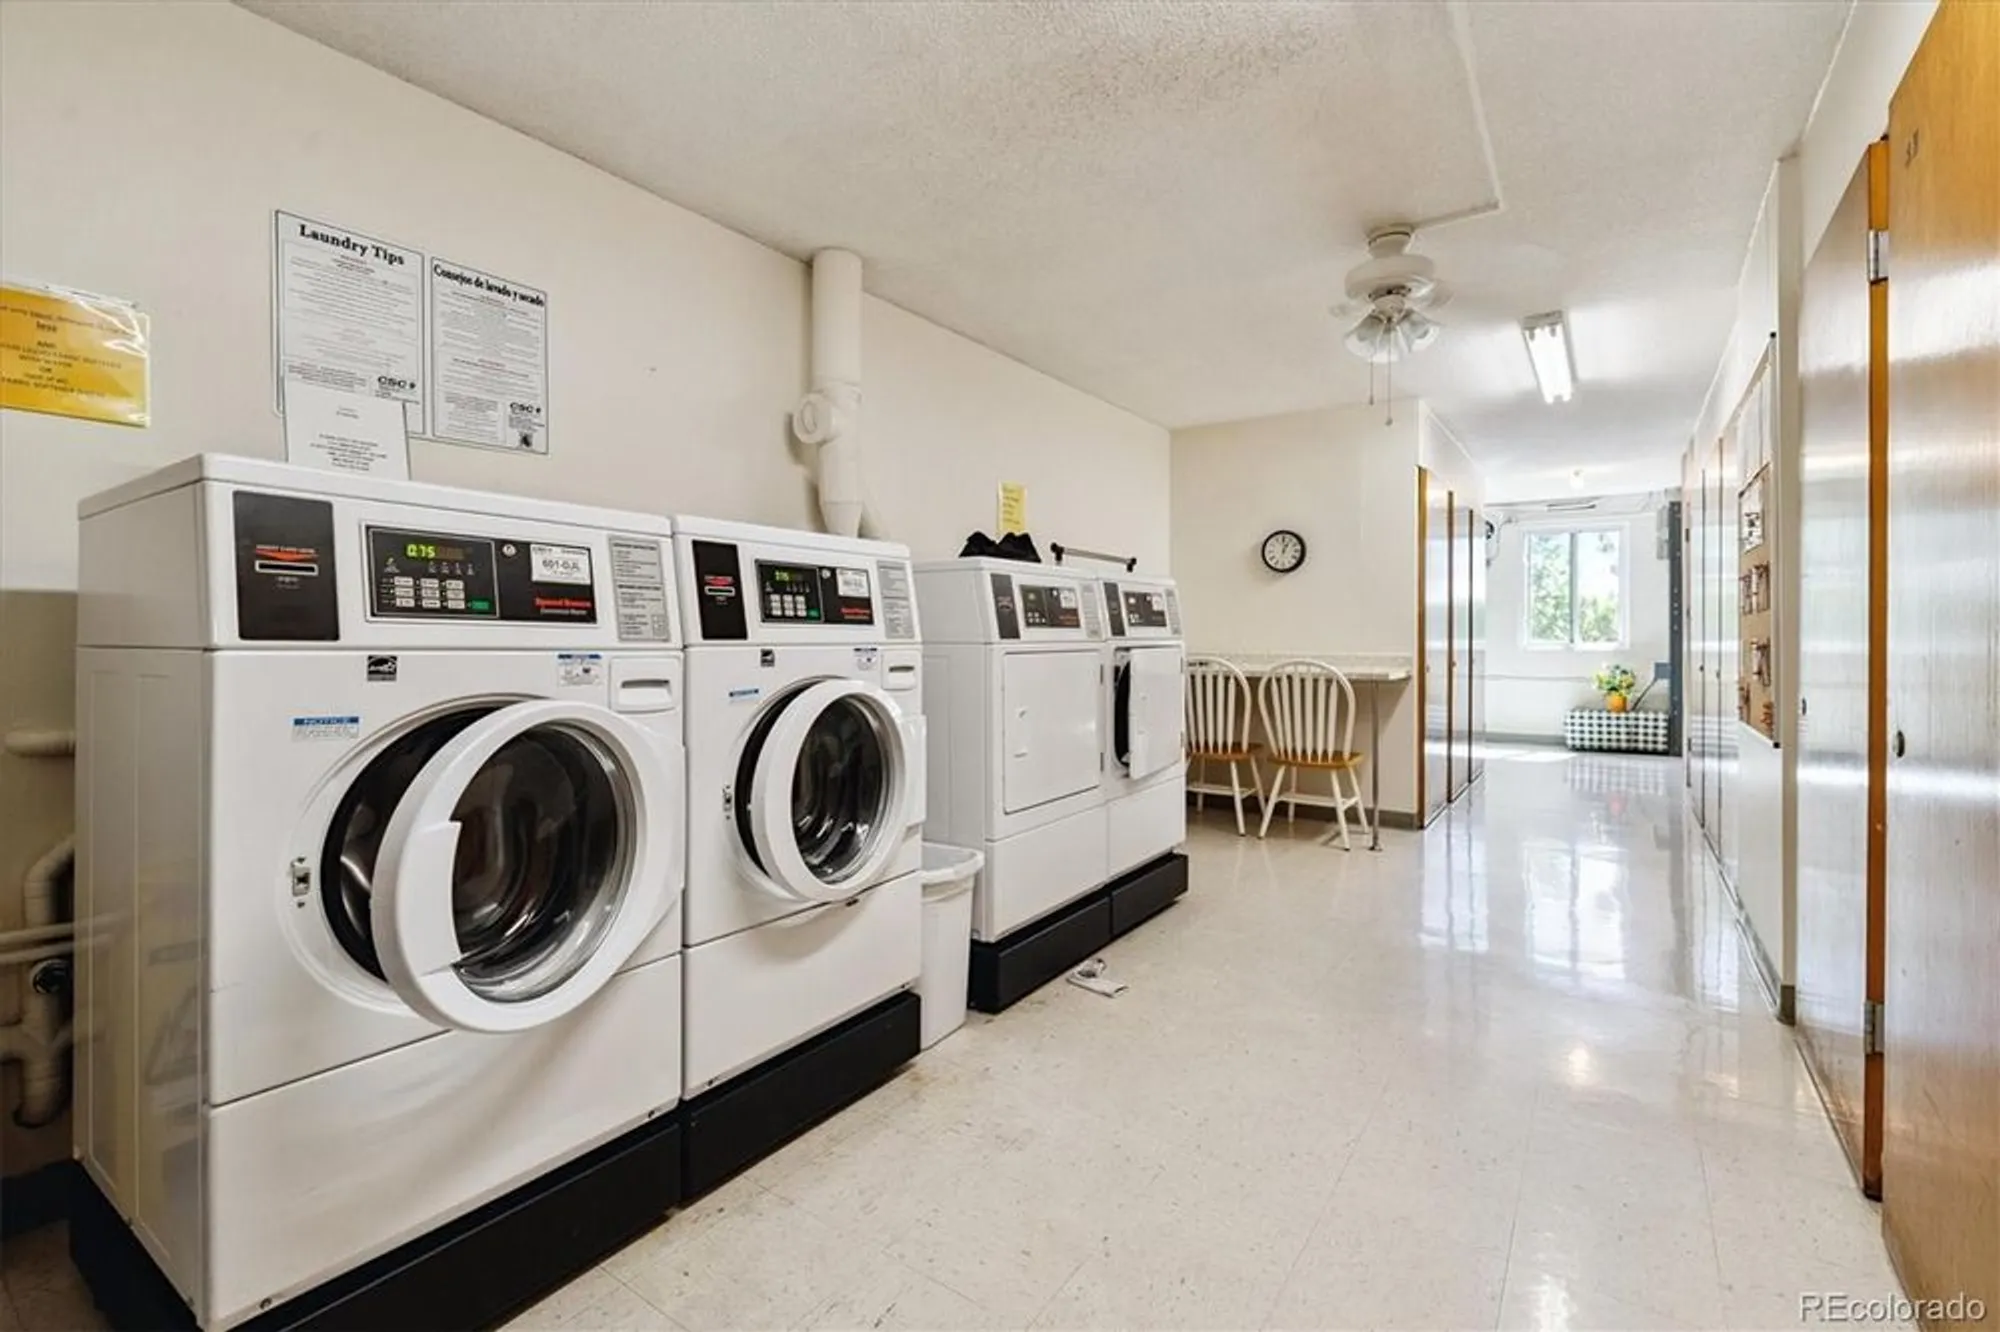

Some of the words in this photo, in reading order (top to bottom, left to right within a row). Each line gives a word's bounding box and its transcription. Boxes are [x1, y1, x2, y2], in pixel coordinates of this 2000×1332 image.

[299, 224, 368, 257] Laundry
[371, 244, 405, 266] Tips
[434, 263, 474, 286] Consejos
[474, 276, 485, 289] de
[485, 279, 512, 298] lavado
[512, 290, 519, 303] y
[378, 375, 407, 389] CSC
[509, 401, 534, 414] CSC
